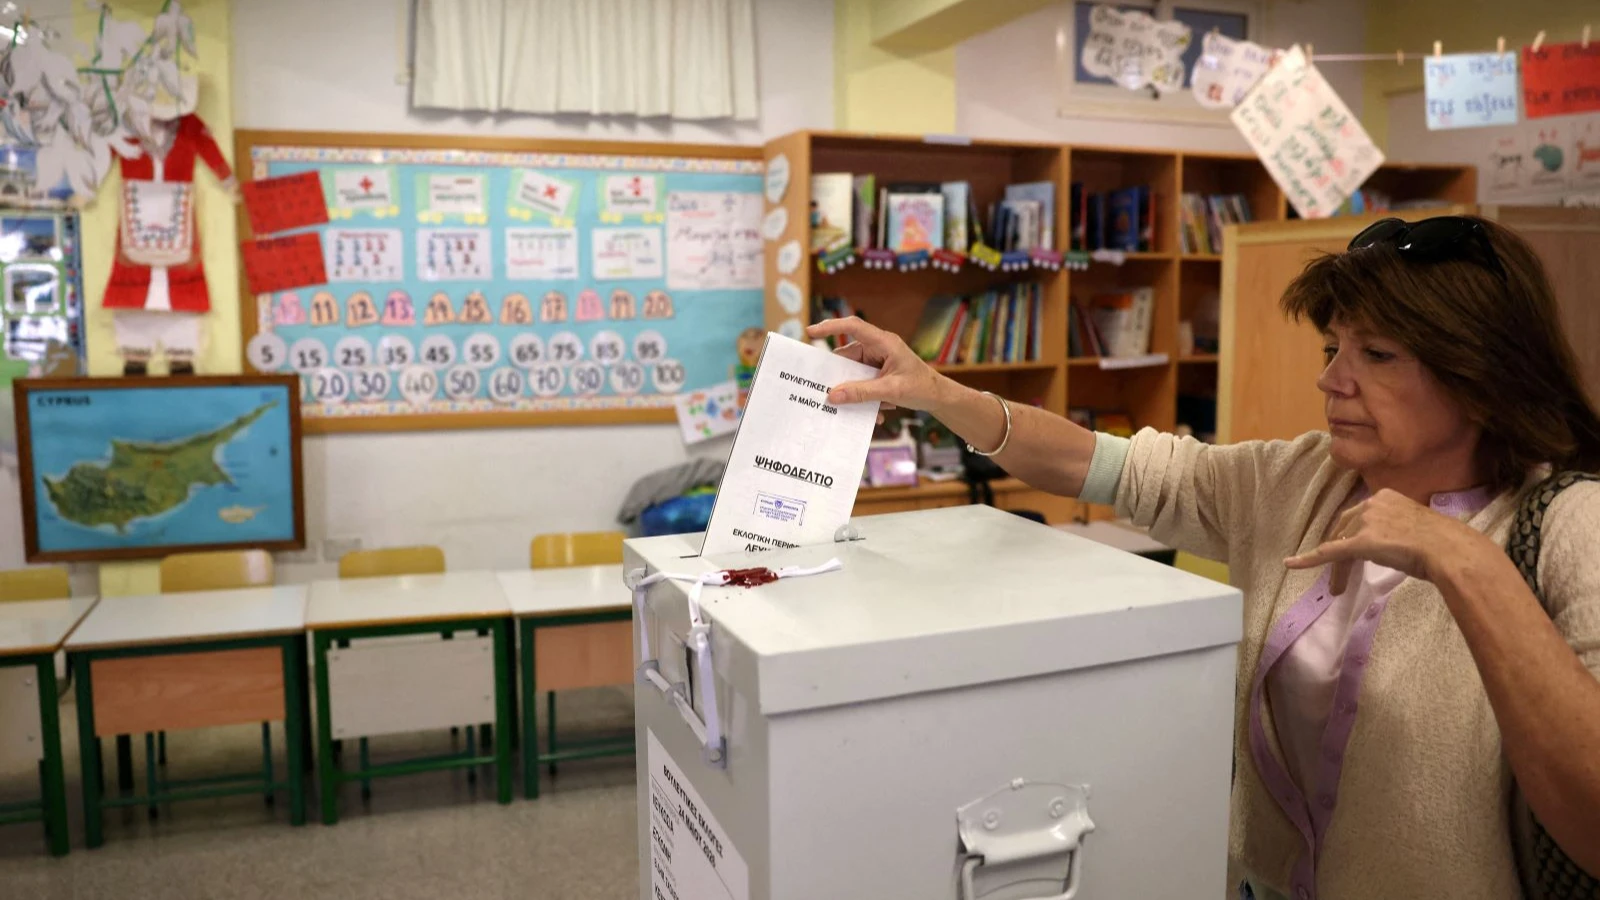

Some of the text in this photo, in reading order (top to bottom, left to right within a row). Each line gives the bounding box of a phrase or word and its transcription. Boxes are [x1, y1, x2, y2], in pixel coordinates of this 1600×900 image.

[314, 300, 332, 322] 11
[350, 300, 373, 321] 12
[389, 299, 411, 319] 13
[464, 298, 485, 321] 15
[506, 299, 526, 323] 16
[261, 341, 660, 368] 5 15 25 35 45 55 65 75 85 95
[318, 364, 685, 397] 20 30 40 50 60 70 80 90 100
[779, 371, 826, 393] ΒΟΥΛΕΥΤΙΚΕΣ
[37, 396, 91, 407] CYPRUS
[789, 393, 798, 402] 24
[821, 404, 838, 415] 2026
[754, 455, 834, 487] ΨΗΦΟΔΕΛΤΙΟ
[732, 528, 771, 544] ΕΚΛΟΓΙΚΗ
[663, 764, 698, 820] ΒΟΥΛΕΥΤΙΚΕΣ
[698, 813, 724, 859] ΕΚΛΟΓΕΣ
[678, 803, 686, 822] 24
